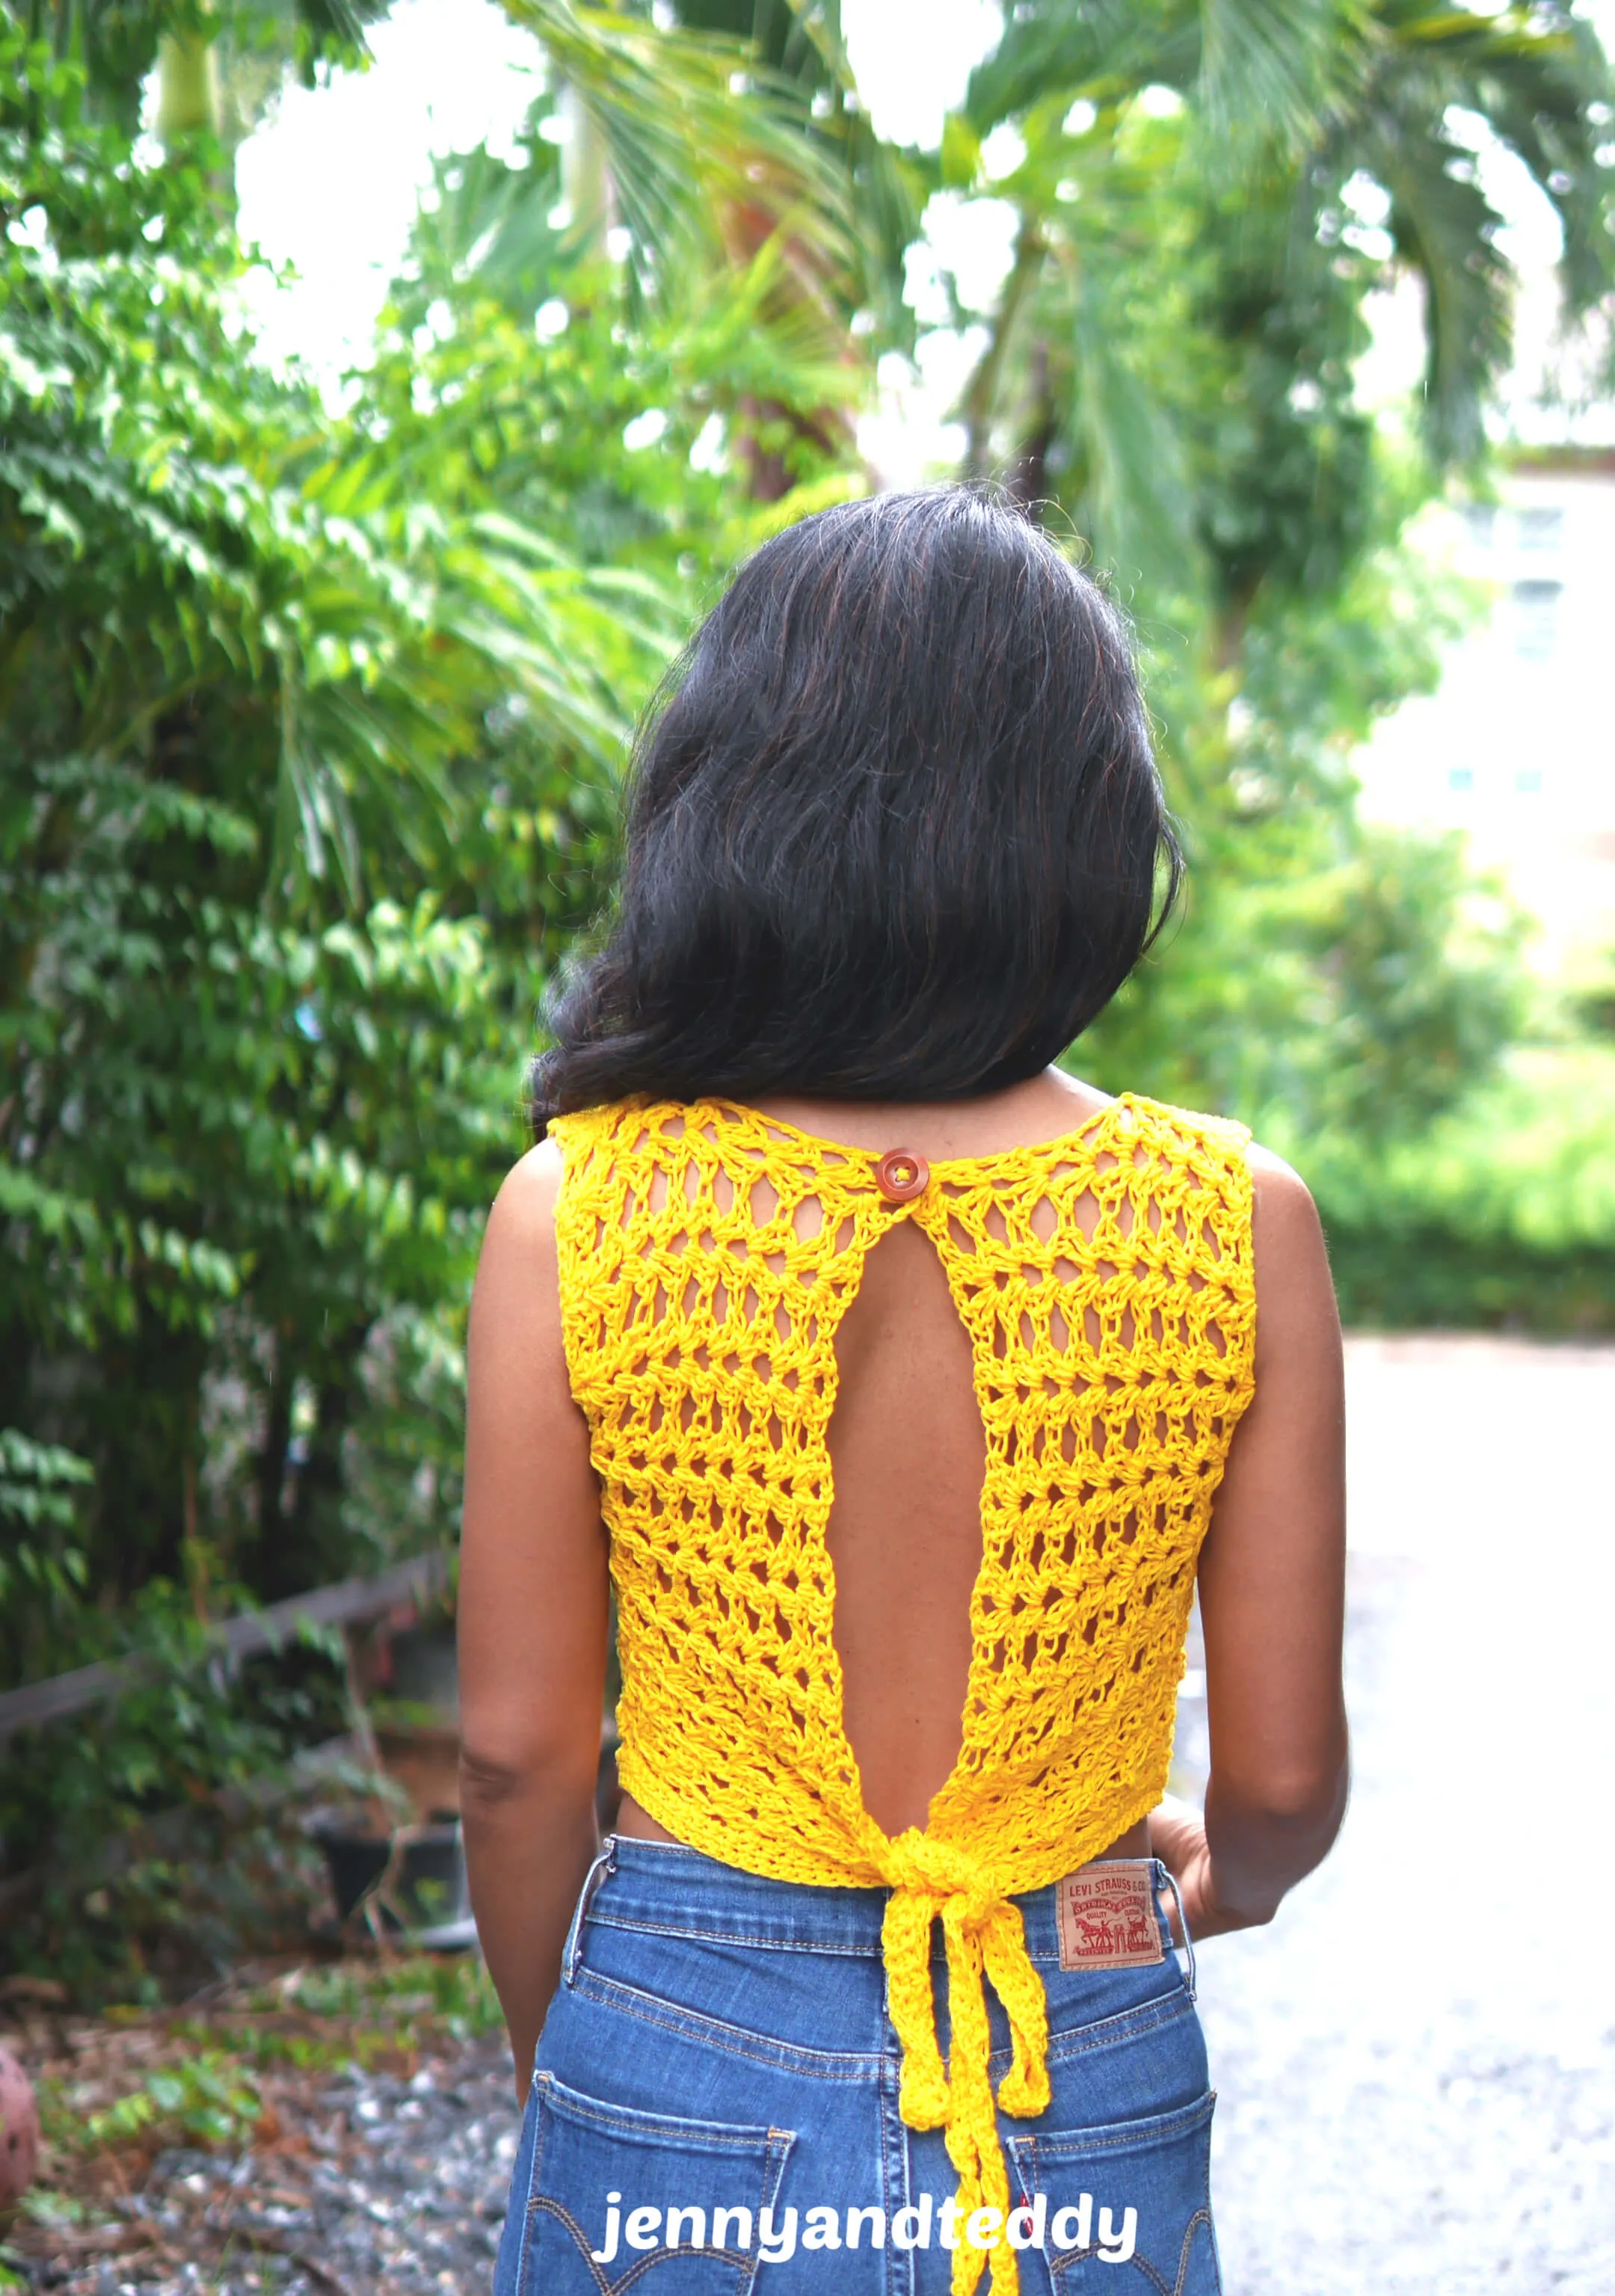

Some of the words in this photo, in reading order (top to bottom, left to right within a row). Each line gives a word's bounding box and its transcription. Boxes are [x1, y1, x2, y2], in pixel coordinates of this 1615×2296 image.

[1070, 1884, 1092, 1897] LEVI
[1095, 1877, 1131, 1892] STRAUSS
[1086, 1912, 1107, 1920] QUALITY
